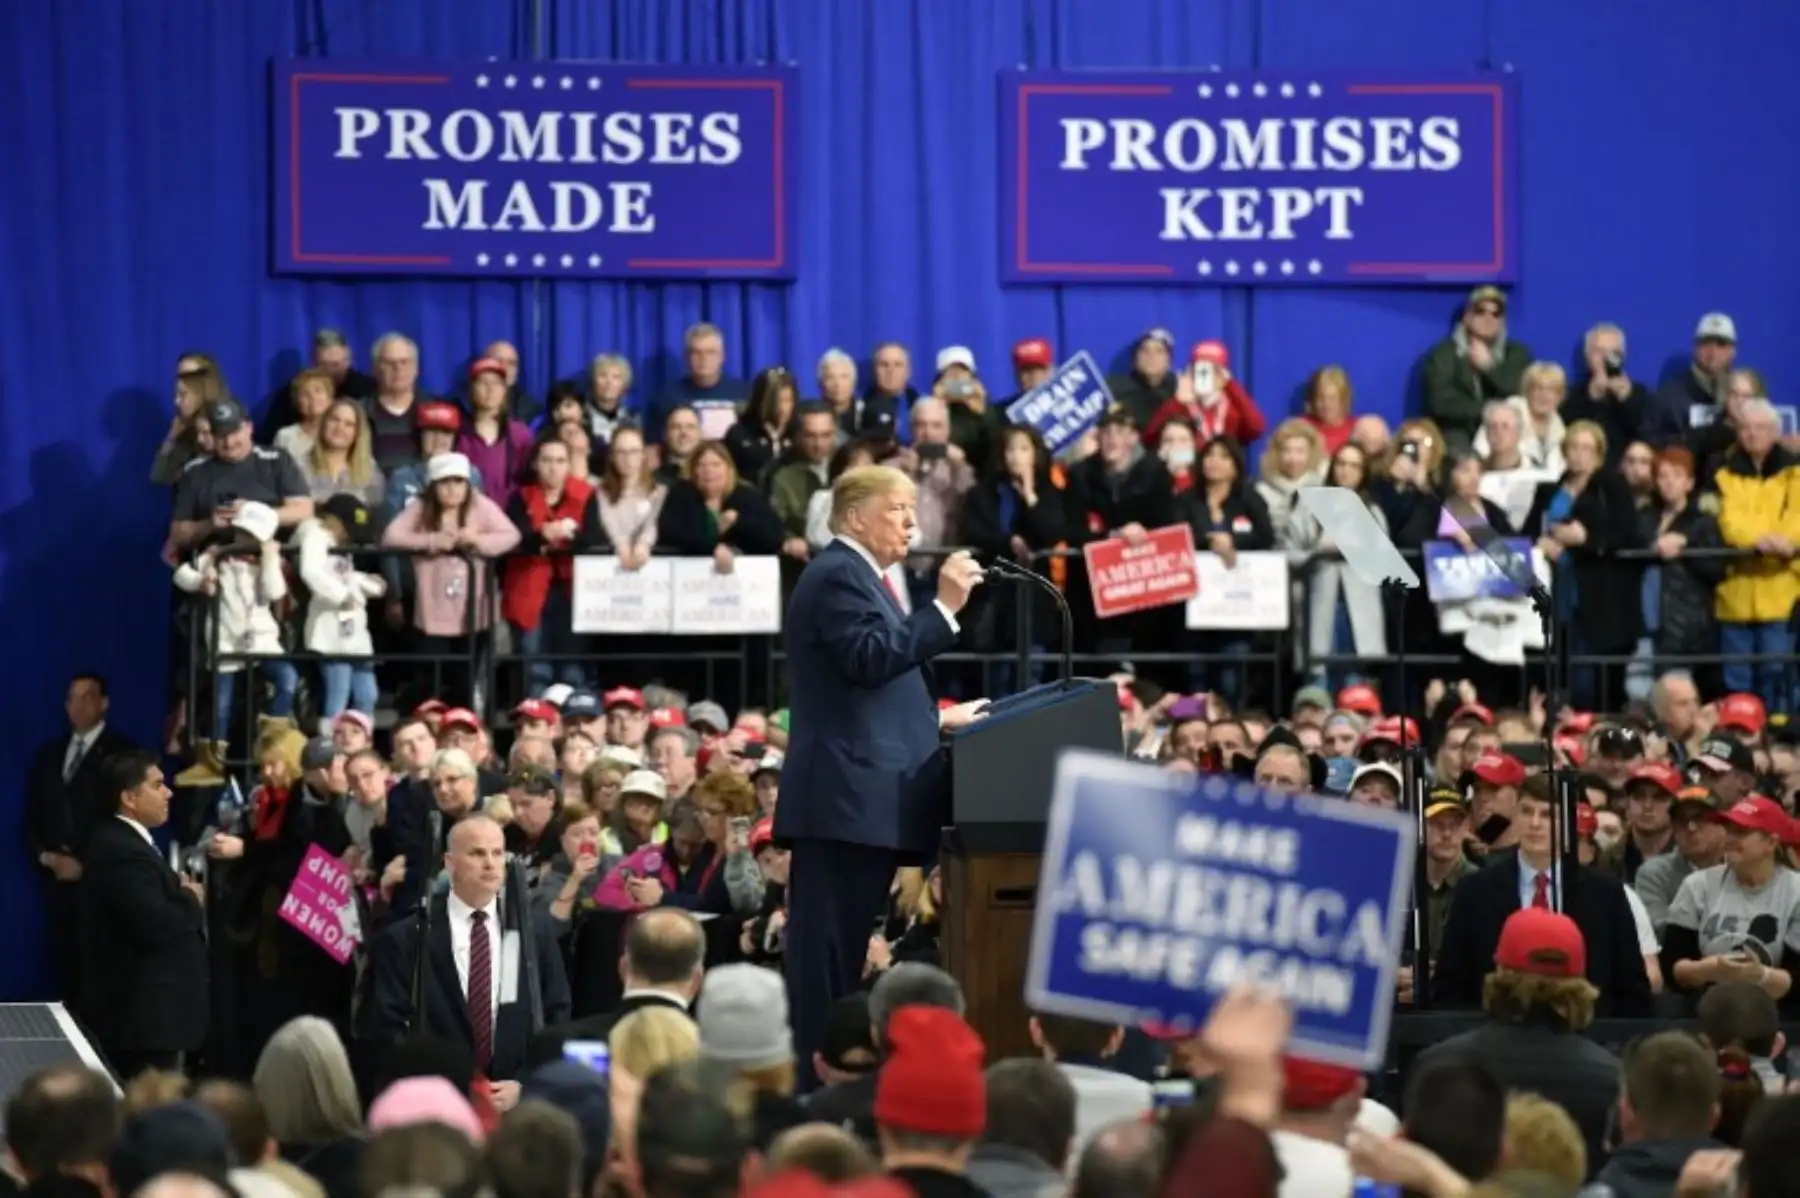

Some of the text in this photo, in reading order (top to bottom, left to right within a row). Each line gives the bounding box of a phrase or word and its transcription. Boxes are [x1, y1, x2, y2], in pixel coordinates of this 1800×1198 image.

[333, 107, 742, 165] PROMISES
[1059, 117, 1461, 172] PROMISES
[422, 178, 655, 233] MADE
[1159, 187, 1364, 241] KEPT
[1023, 364, 1087, 425] DRAIN
[1098, 550, 1191, 584] AMERICA
[1102, 579, 1146, 600] GREAT
[1148, 571, 1191, 590] AGAIN
[1173, 810, 1300, 877] MAKE
[281, 892, 353, 958] WOMEN
[1055, 848, 1392, 970] AMERICA
[1077, 920, 1357, 1018] SAFE AGAIN
